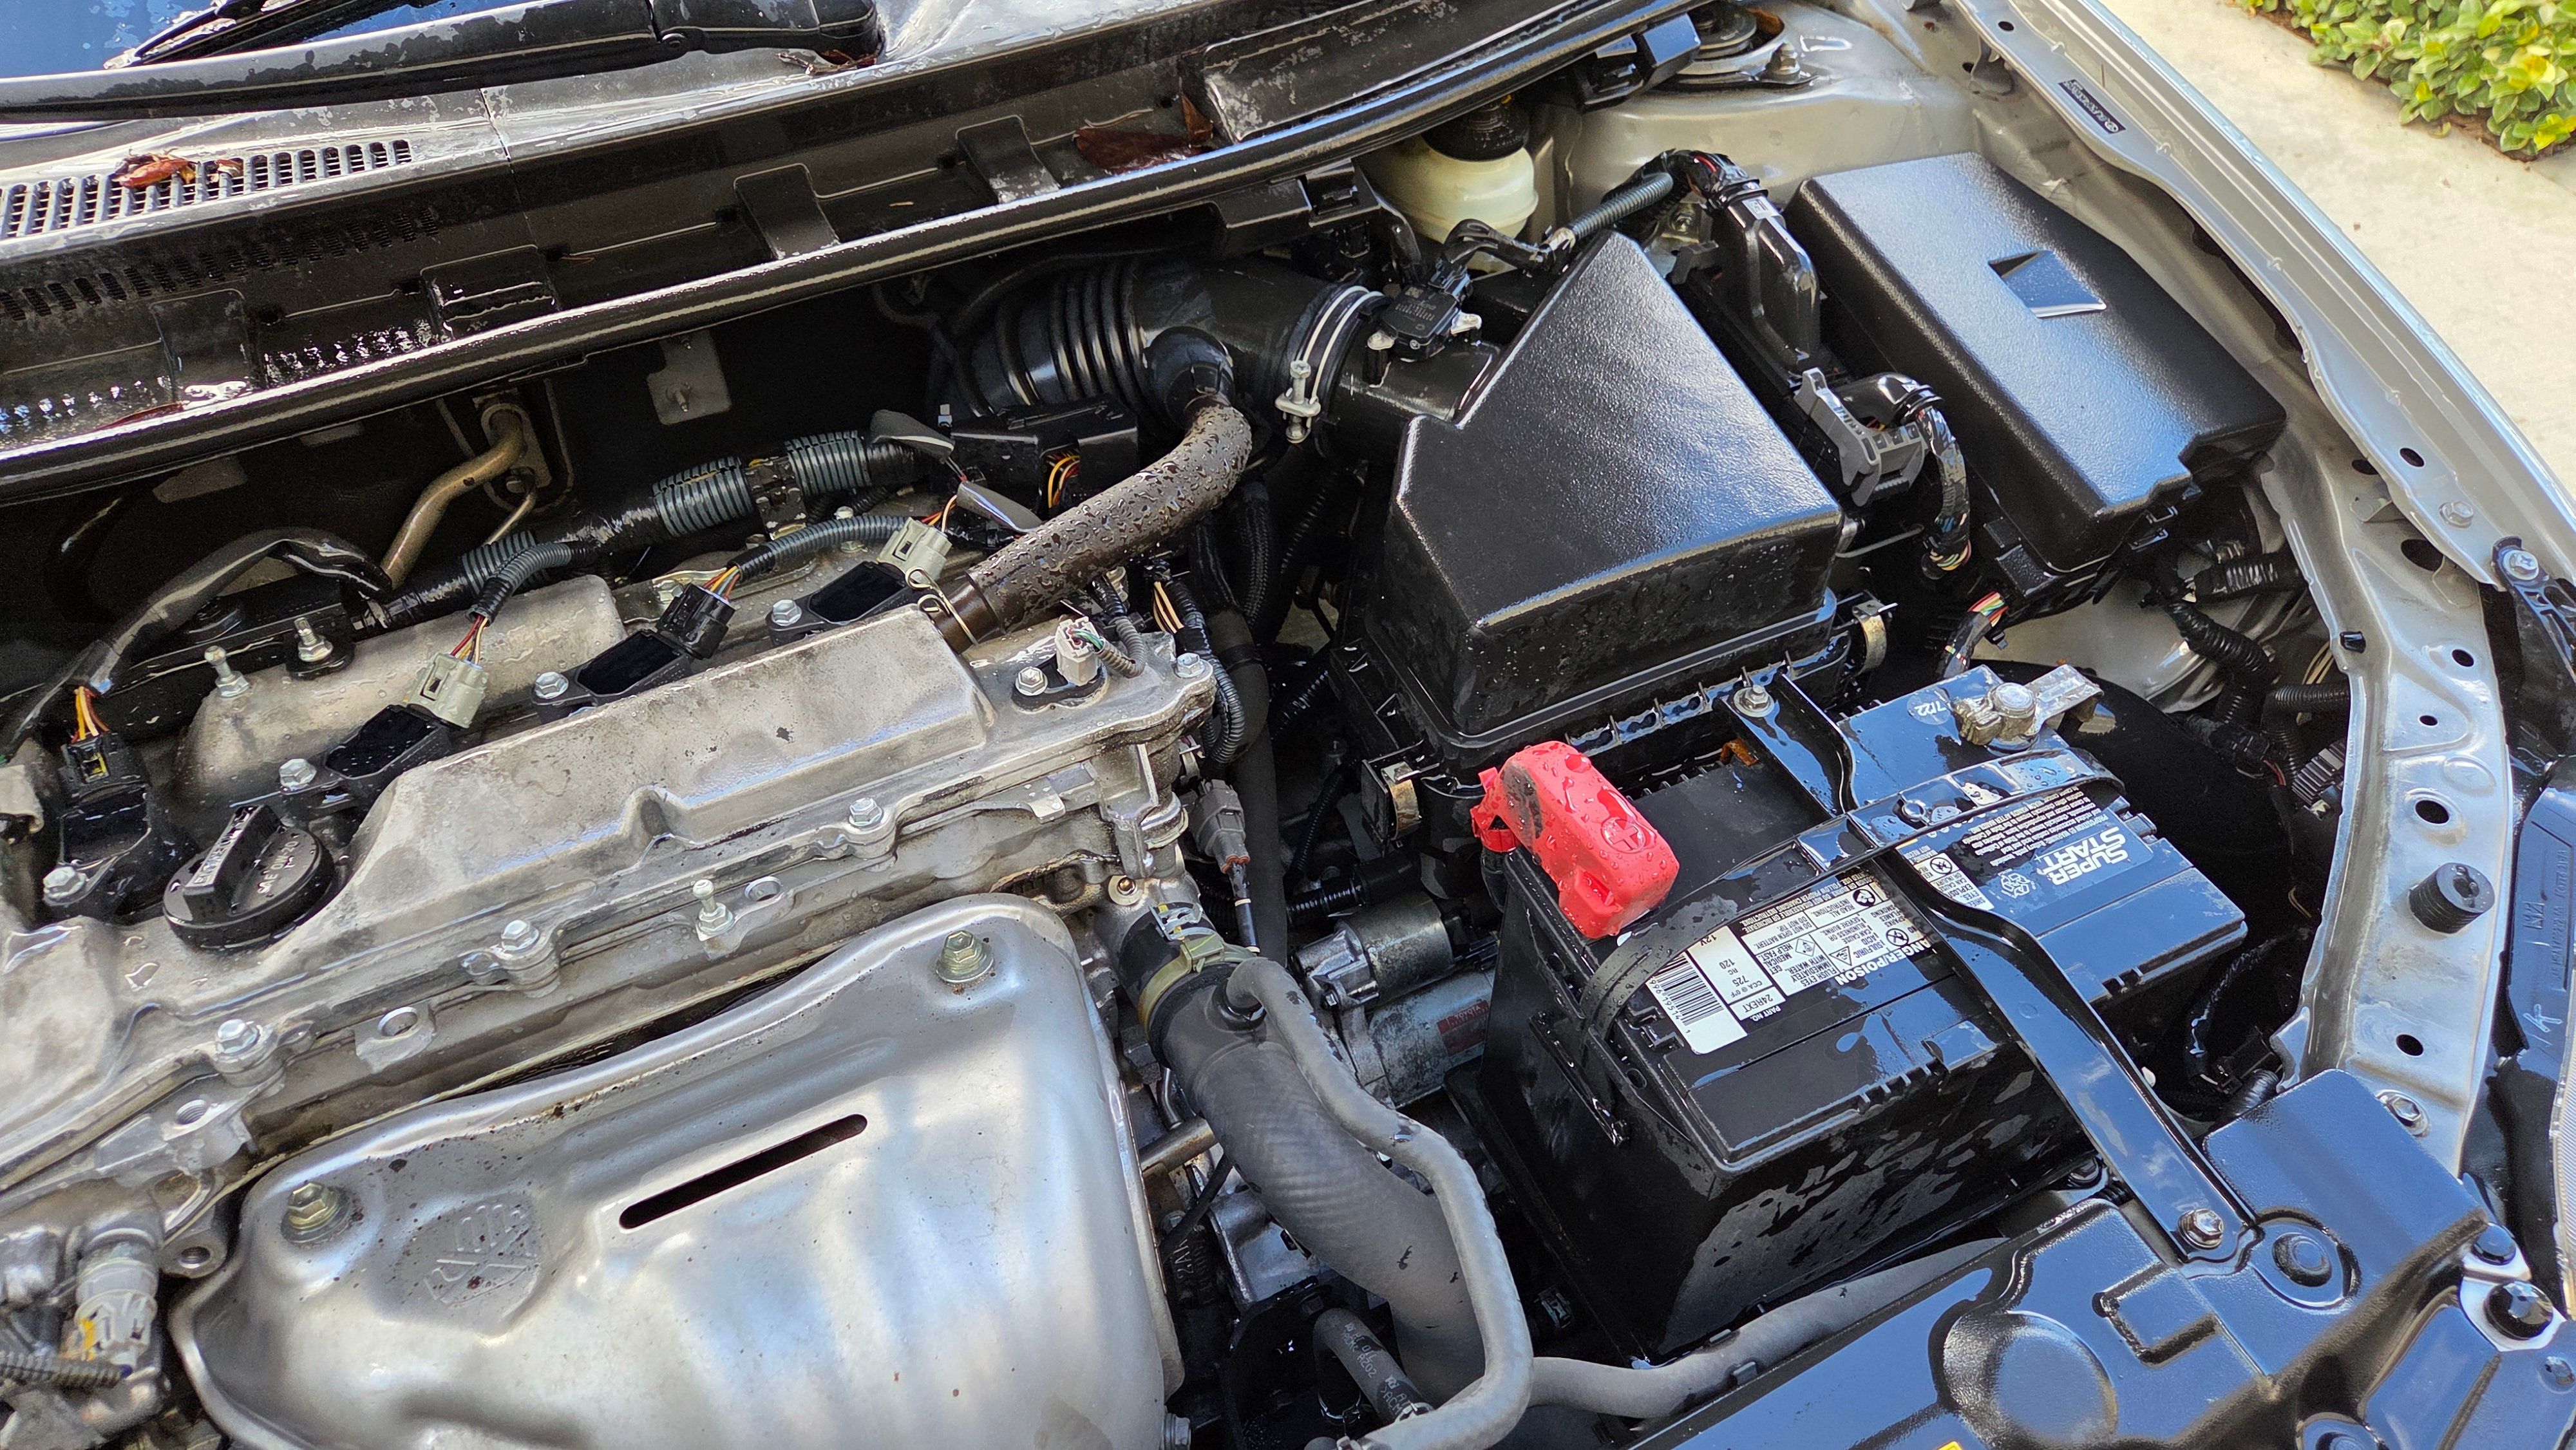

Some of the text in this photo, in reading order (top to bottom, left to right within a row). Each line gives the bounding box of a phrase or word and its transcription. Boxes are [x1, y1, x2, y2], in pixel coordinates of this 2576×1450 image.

[2036, 825, 2127, 876] START
[2047, 843, 2129, 887] SUPER
[254, 871, 279, 895] SAE
[1933, 875, 1954, 887] INJURY.
[1938, 876, 1966, 892] CAN CAUSE
[1959, 889, 1979, 901] EYES.
[1965, 896, 1985, 909] SHIEL
[1810, 897, 1850, 918] INSTRUCTIONS.
[1828, 903, 1855, 918] READ ALL
[1870, 903, 1896, 918] SMOKING
[1878, 909, 1900, 922] FLAMES
[1776, 923, 1789, 932] TIP.
[1786, 919, 1799, 928] NOT
[1819, 916, 1861, 936] SEVERE BURNS.
[1835, 921, 1866, 938] BLINDNESS
[1698, 933, 1717, 946] 12V
[1752, 921, 1812, 950] DO NOT OPEN BATTERY.
[1841, 928, 1871, 944] CAN CAUSE
[1860, 934, 1877, 945] ACID
[1757, 942, 1793, 962] HELP FAST.
[1852, 941, 1884, 958] SULFURIC
[1718, 957, 1736, 970] 120
[1762, 952, 1792, 968] MEDICAL
[1784, 954, 1826, 975] WITH WATER.
[1833, 937, 1932, 986] ANGER/POISON
[1726, 967, 1738, 975] RC
[1767, 964, 1783, 975] GET
[1789, 961, 1832, 982] IMMEDIATELY
[1799, 967, 1837, 987] FLUSH EYES
[1730, 974, 1749, 987] 725
[1747, 979, 1763, 990] CCA
[1741, 993, 1773, 1012] 24REXT
[1454, 1005, 1481, 1019] TOYOTA
[1748, 1004, 1781, 1022] PART NO.
[1361, 1344, 1377, 1362] OIL
